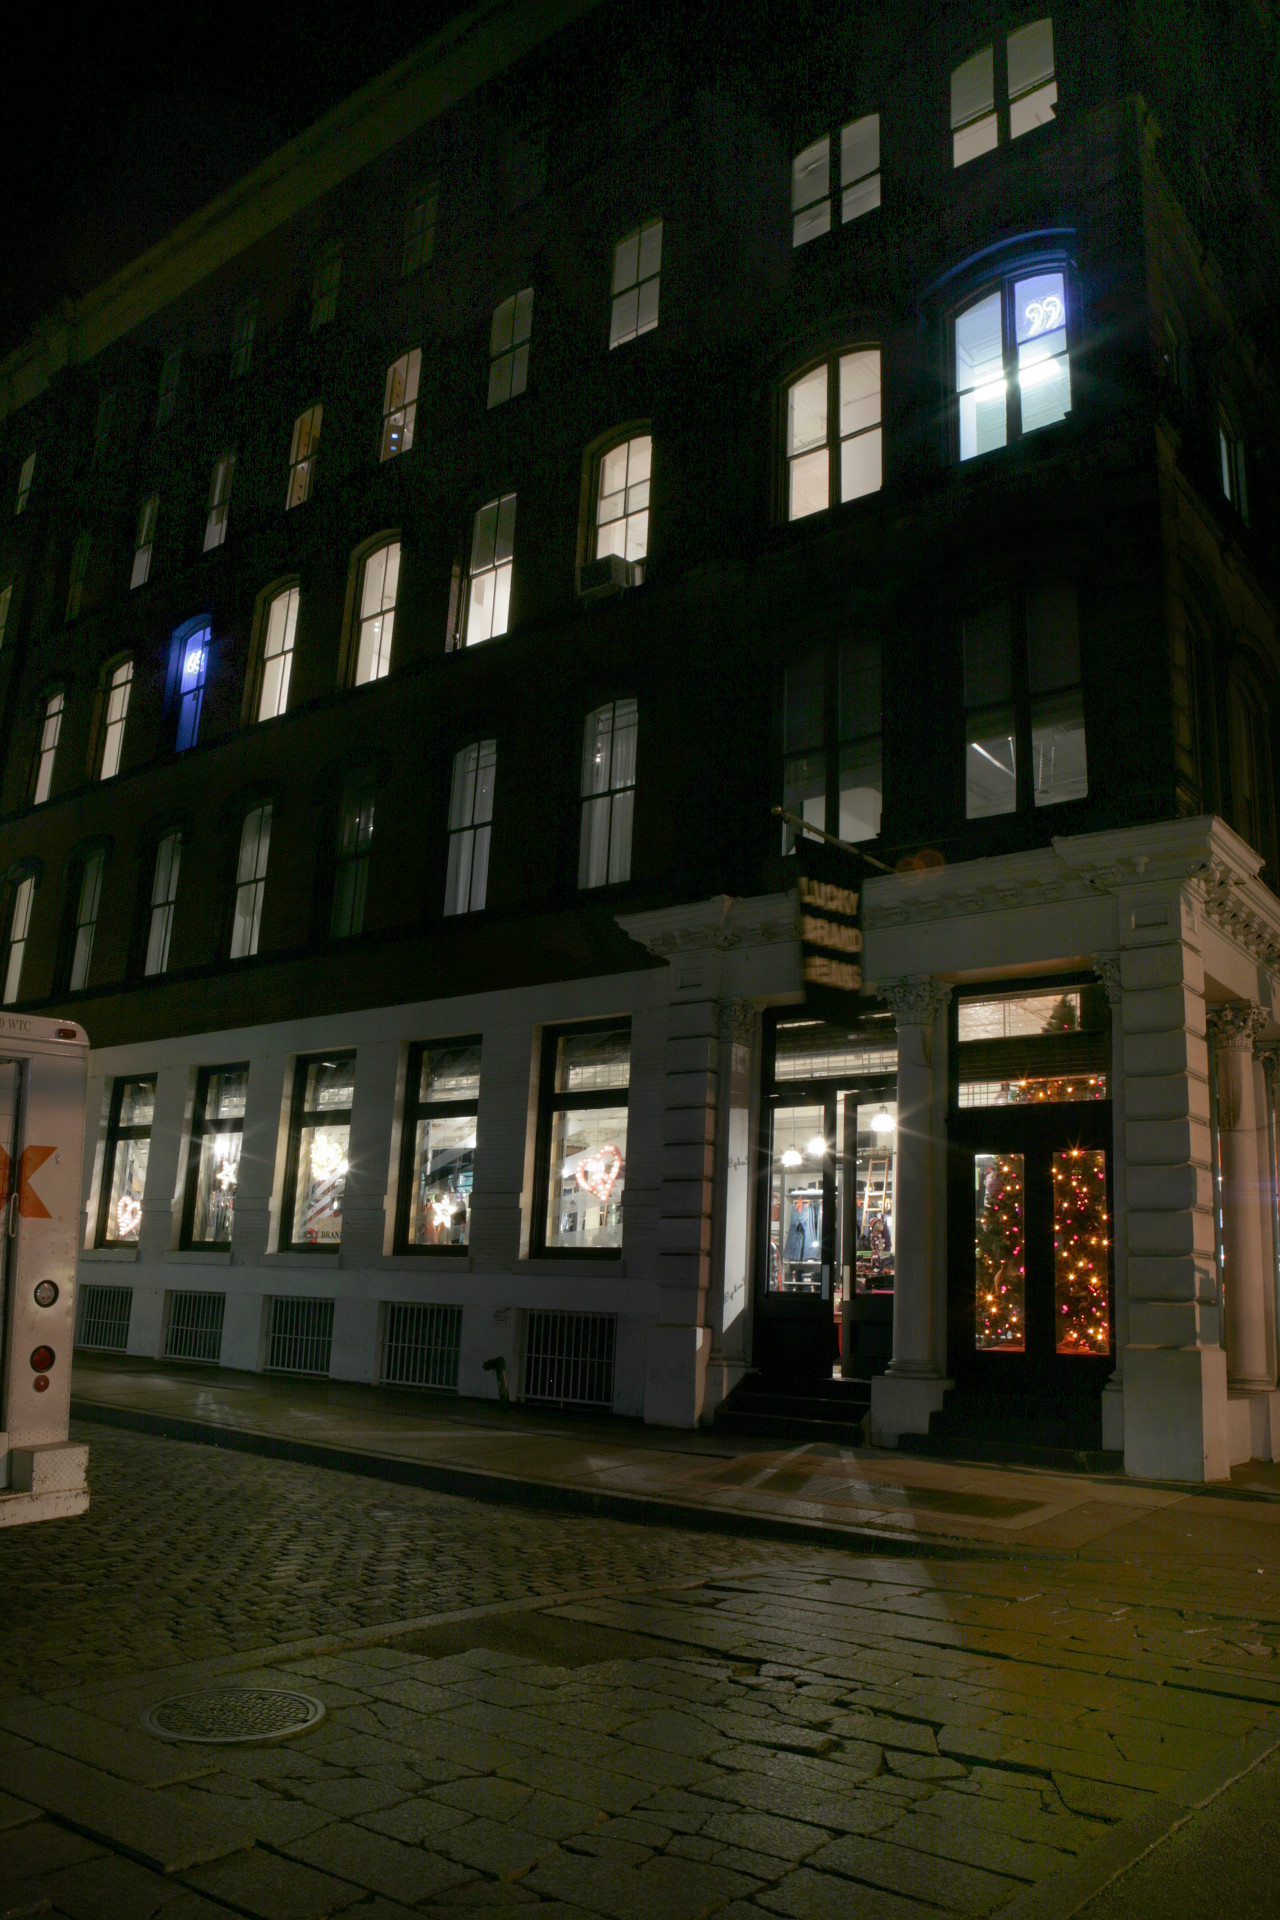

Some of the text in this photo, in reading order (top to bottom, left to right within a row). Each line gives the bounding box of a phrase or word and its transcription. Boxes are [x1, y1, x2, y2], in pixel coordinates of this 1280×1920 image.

[799, 877, 859, 915] LUCKY
[802, 914, 863, 953] BRAND
[8, 1018, 31, 1032] WTC
[321, 1230, 341, 1239] BRAN
